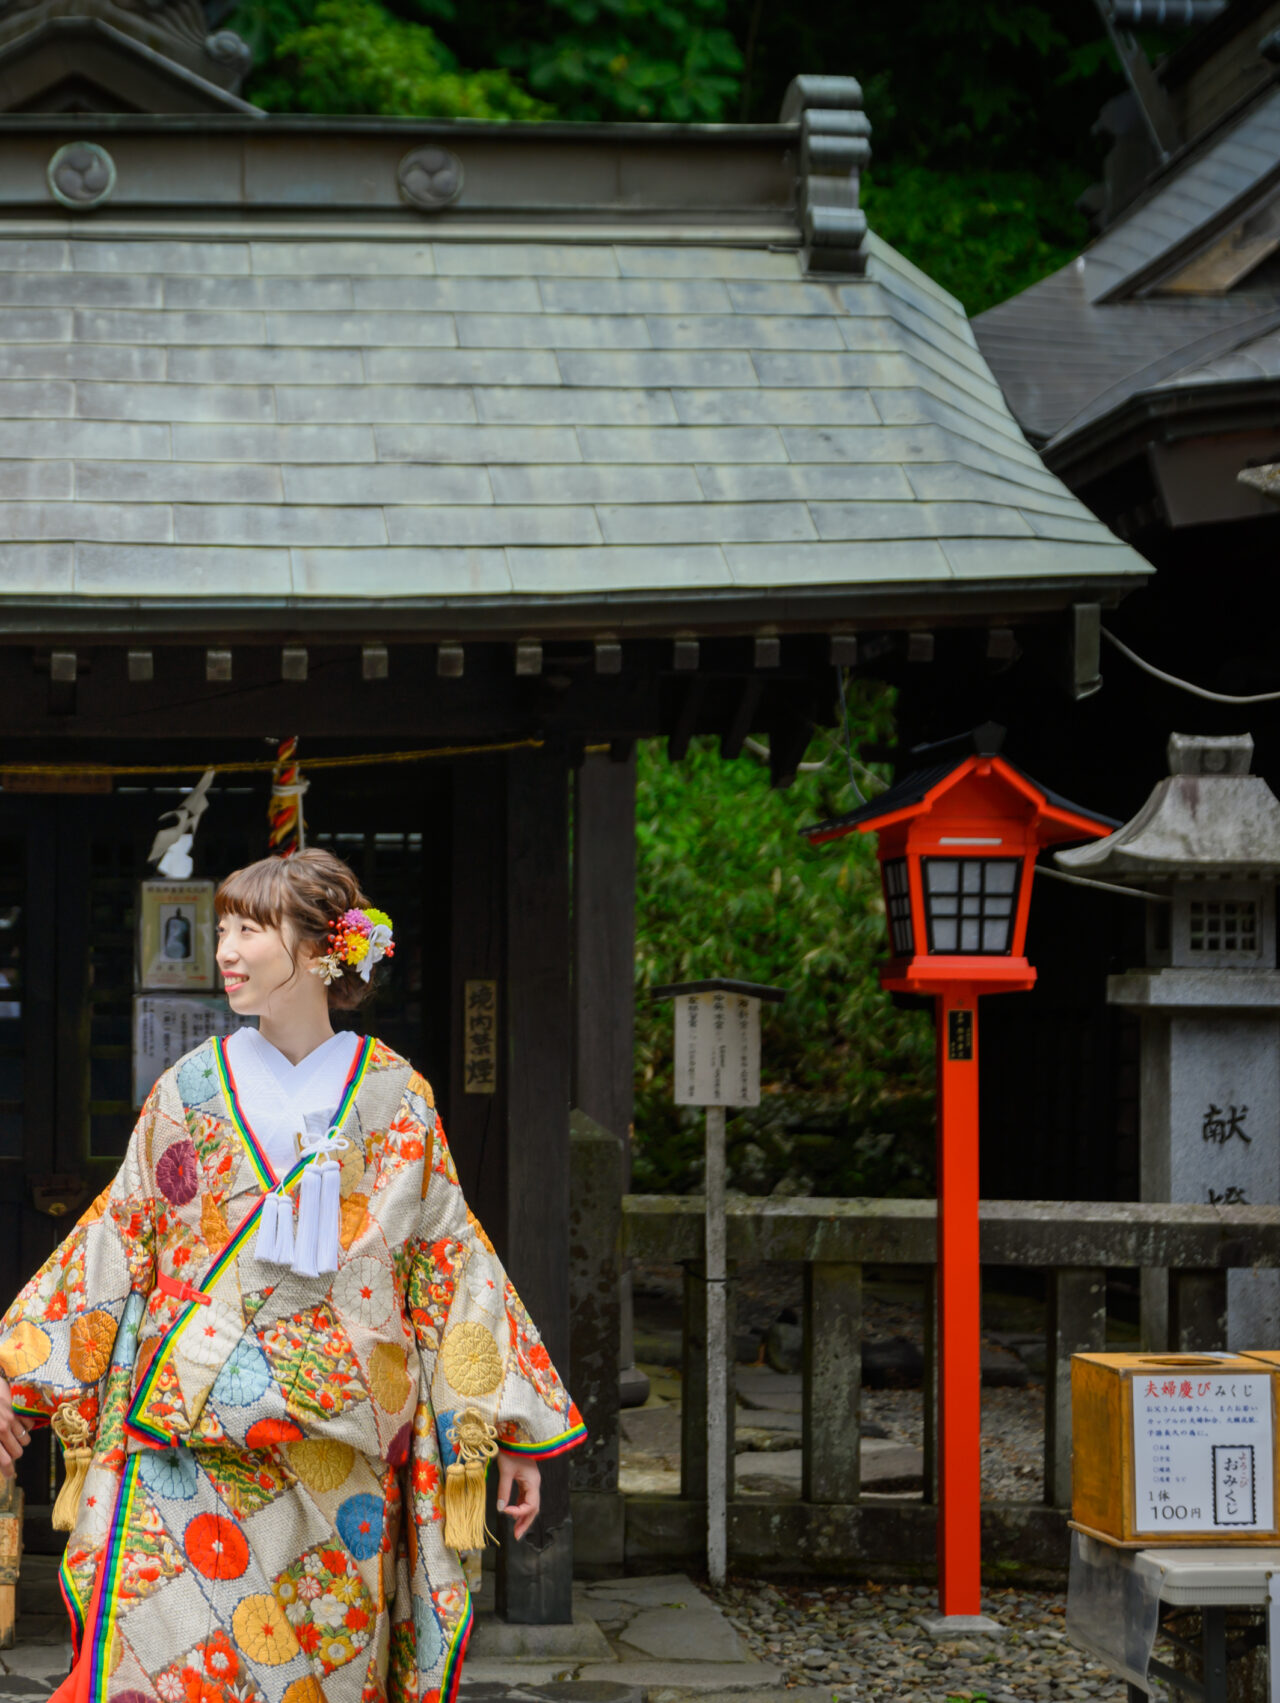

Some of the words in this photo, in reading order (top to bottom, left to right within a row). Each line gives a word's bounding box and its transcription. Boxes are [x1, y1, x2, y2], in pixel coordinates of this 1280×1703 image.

[466, 984, 495, 1084] 境内禁煙
[1150, 1505, 1202, 1520] 100円
[1223, 1457, 1238, 1515] おみくじ
